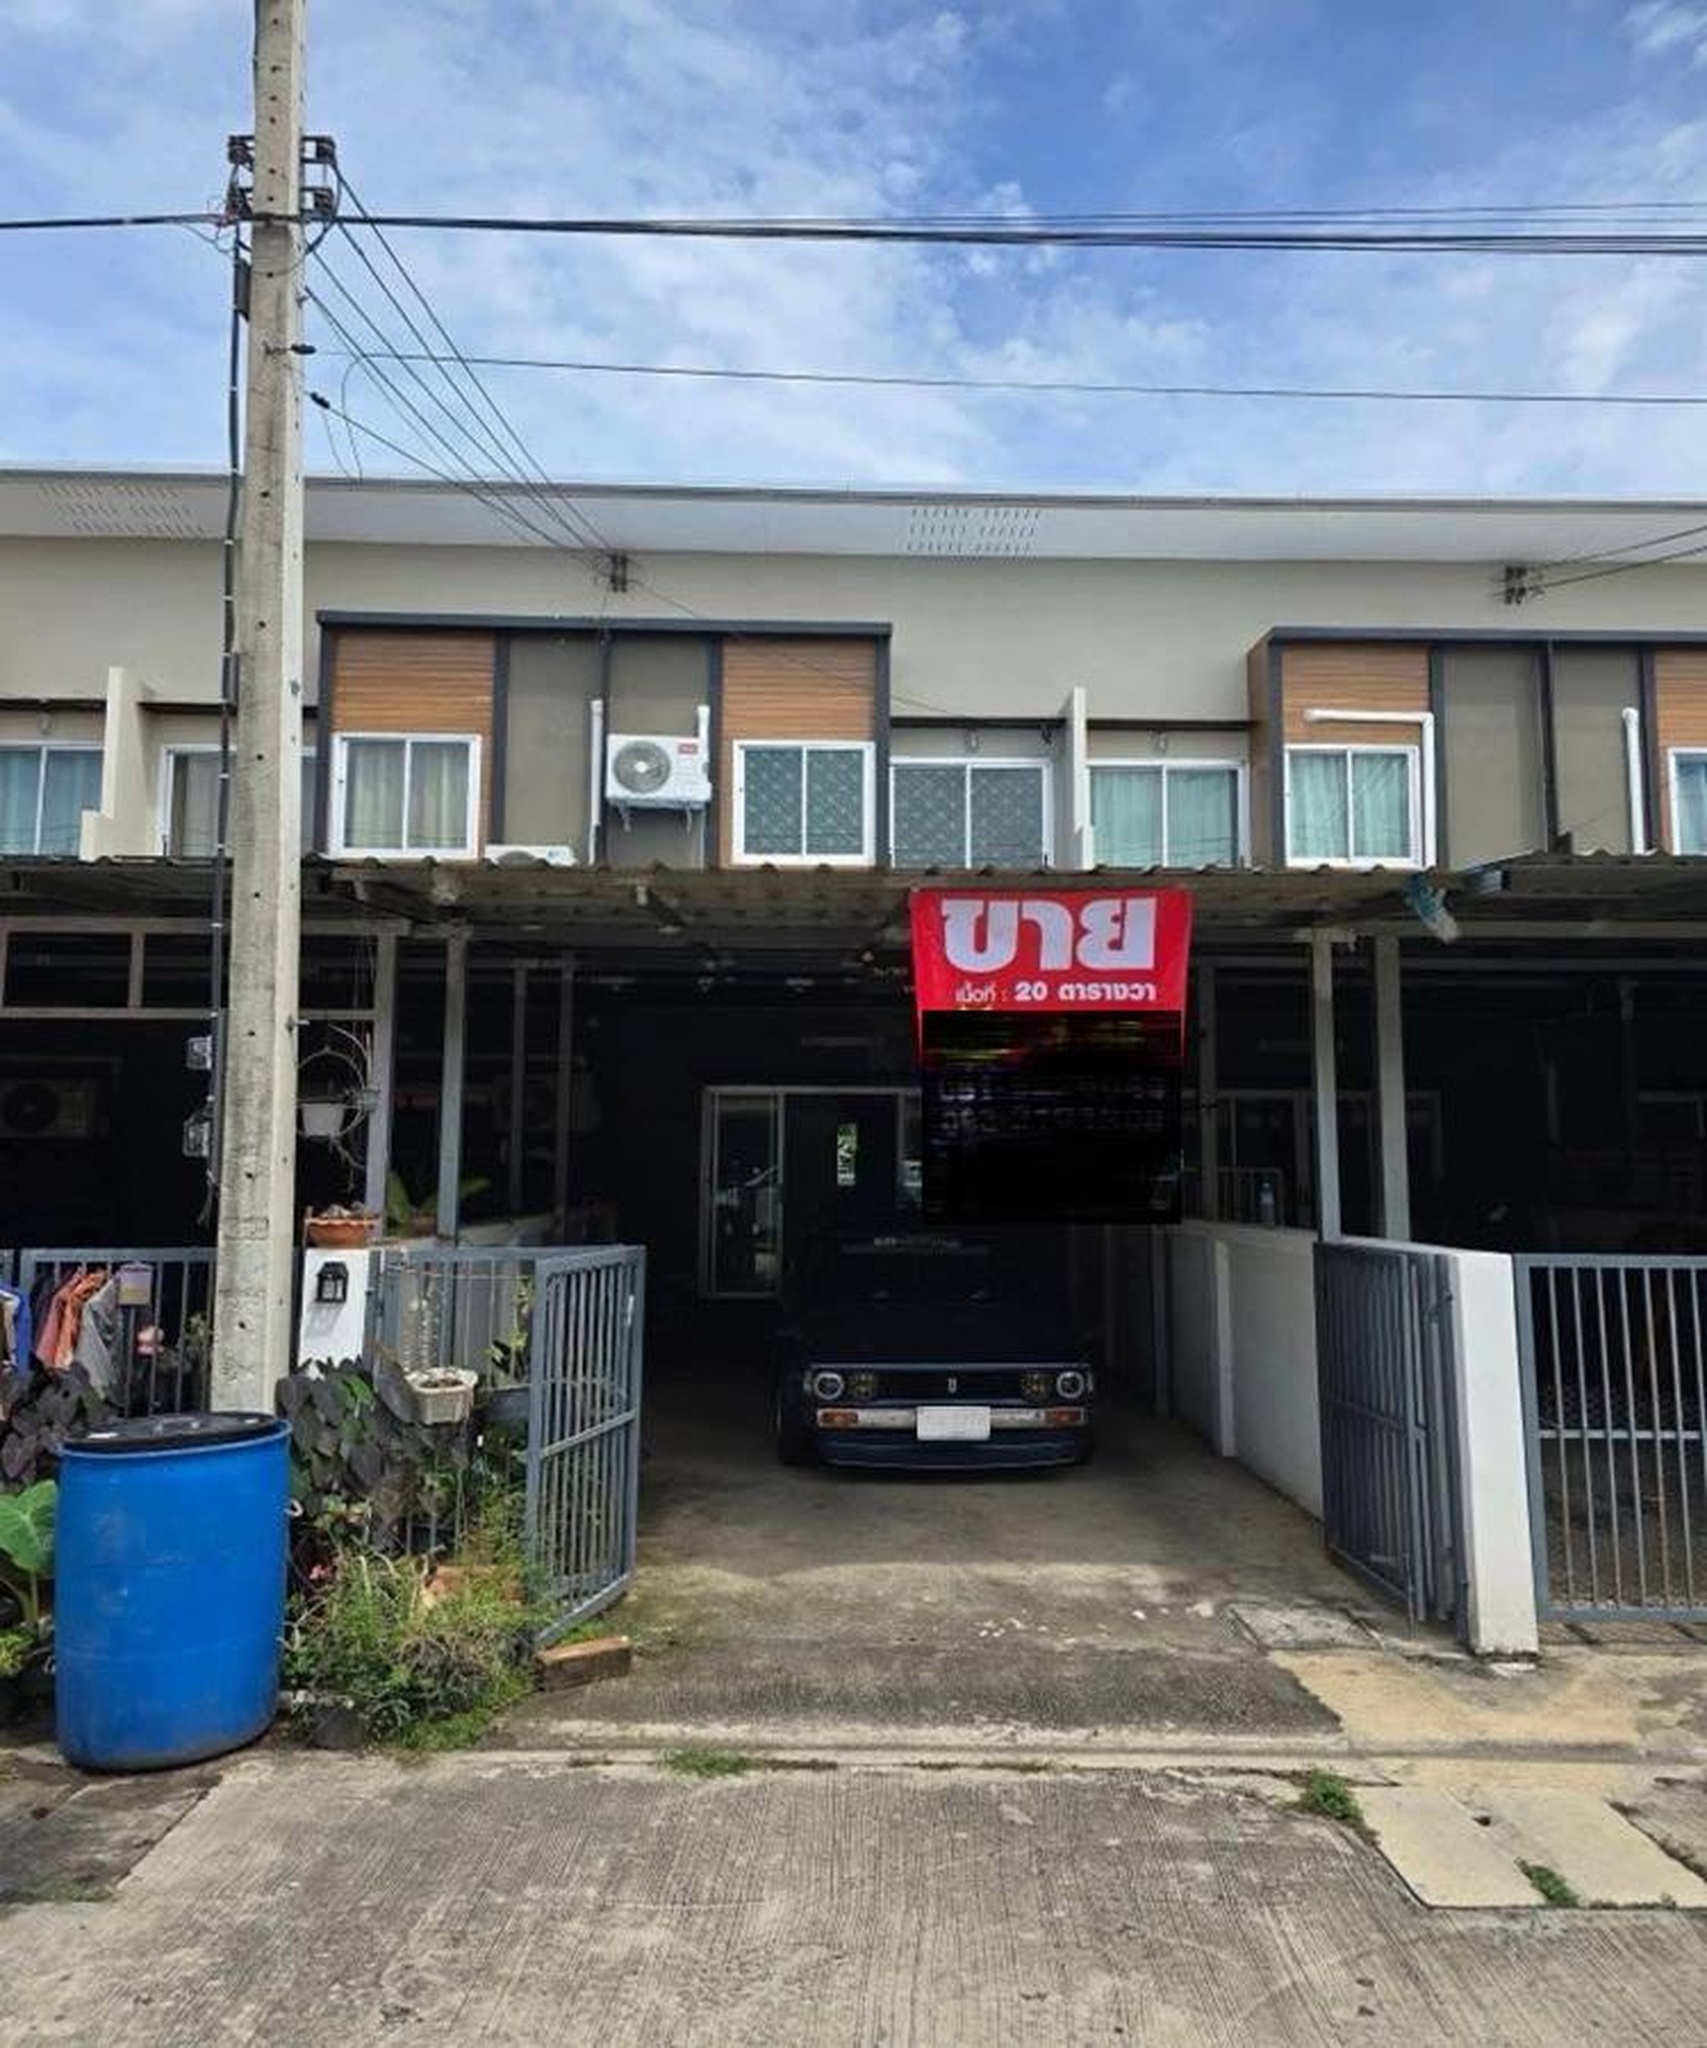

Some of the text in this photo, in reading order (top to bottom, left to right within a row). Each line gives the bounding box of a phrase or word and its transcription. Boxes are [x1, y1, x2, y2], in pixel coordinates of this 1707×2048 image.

[941, 897, 1157, 973] ขาย
[1014, 980, 1049, 1002] 20
[1057, 982, 1157, 1002] ตารางวา
